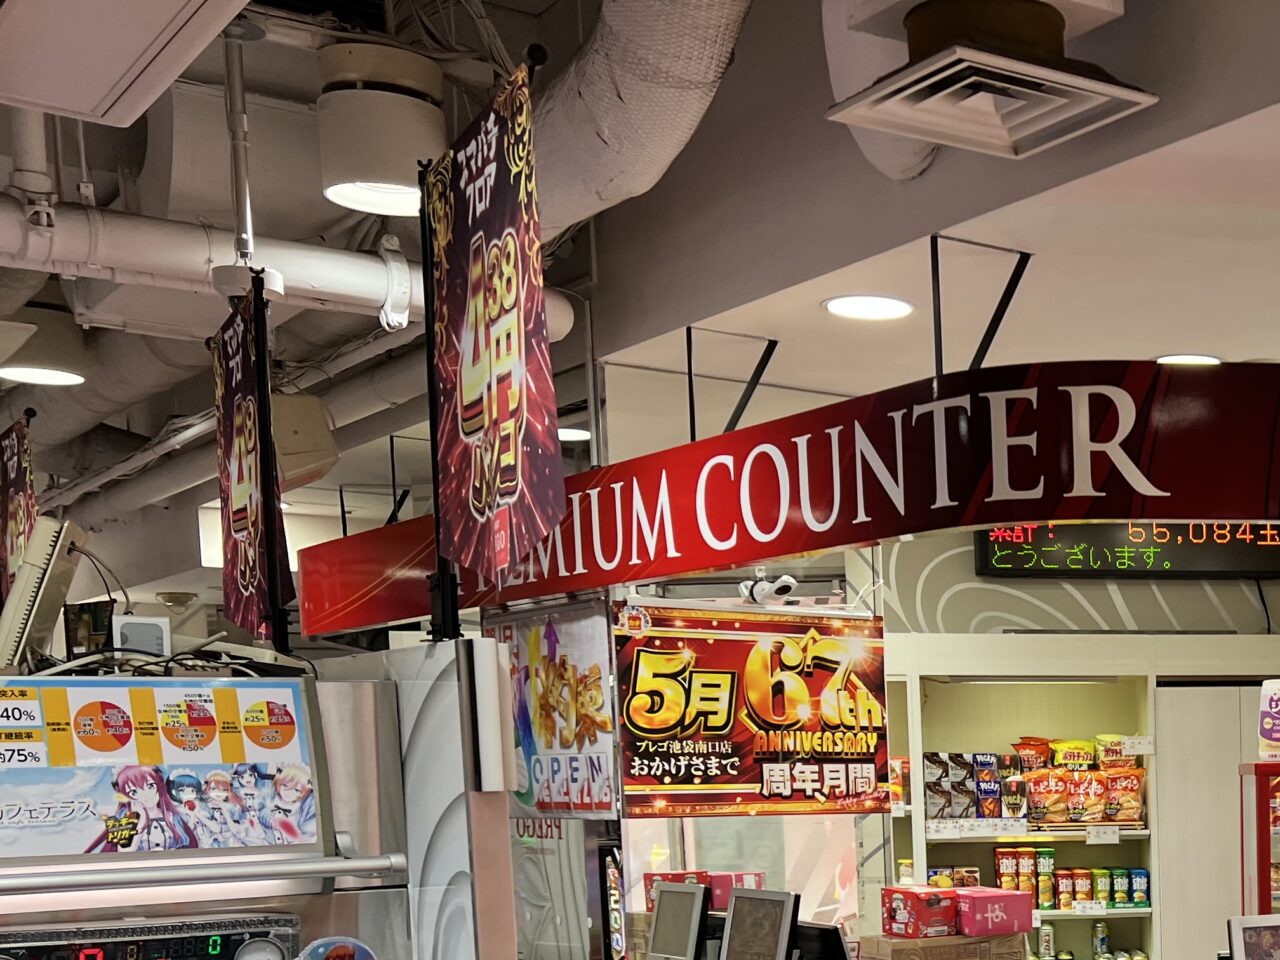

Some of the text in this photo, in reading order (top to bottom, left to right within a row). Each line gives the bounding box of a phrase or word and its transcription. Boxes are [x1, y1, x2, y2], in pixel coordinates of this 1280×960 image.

[455, 384, 1171, 596] MIUM COUNTER
[627, 650, 735, 735] 5月
[636, 741, 732, 754] プレゴ池袋南口店
[754, 731, 878, 753] ANNIVERSARY
[532, 755, 603, 785] OPEN
[631, 756, 740, 776] おかげさまで
[761, 763, 877, 799] 周年月間
[0, 800, 97, 820] フェテラス
